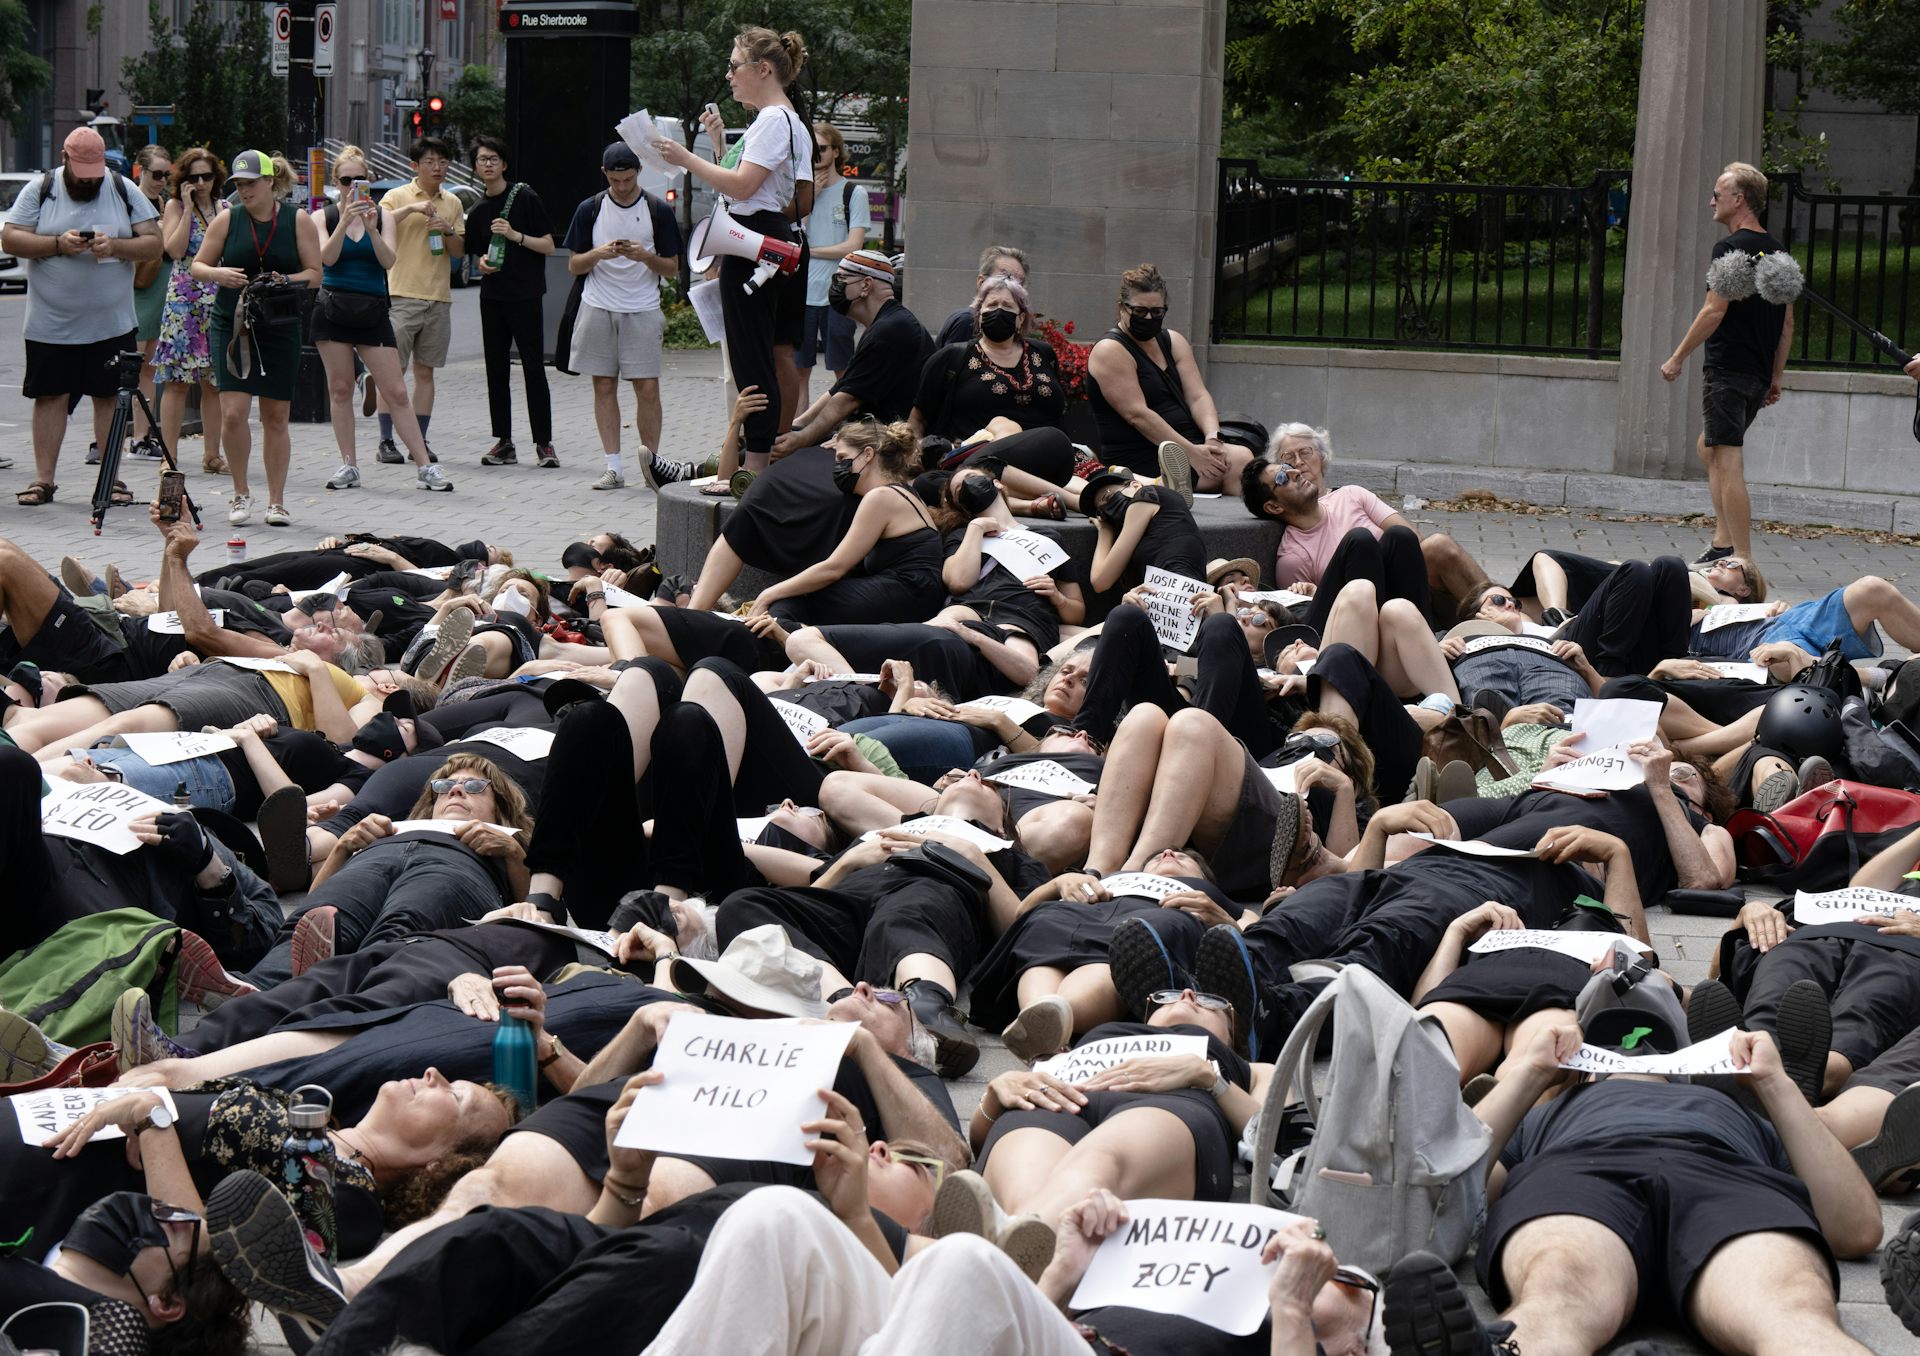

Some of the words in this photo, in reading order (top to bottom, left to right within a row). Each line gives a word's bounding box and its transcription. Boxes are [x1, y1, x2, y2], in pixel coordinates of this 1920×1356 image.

[521, 14, 538, 26] Rue
[539, 13, 587, 26] Sherbrooke
[1149, 573, 1178, 589] JOSIE
[1149, 611, 1179, 629] ARTIN
[1156, 627, 1182, 643] ANNE
[67, 785, 148, 811] RAPH
[57, 806, 117, 831] LÉO
[1132, 1262, 1230, 1292] ZOEY
